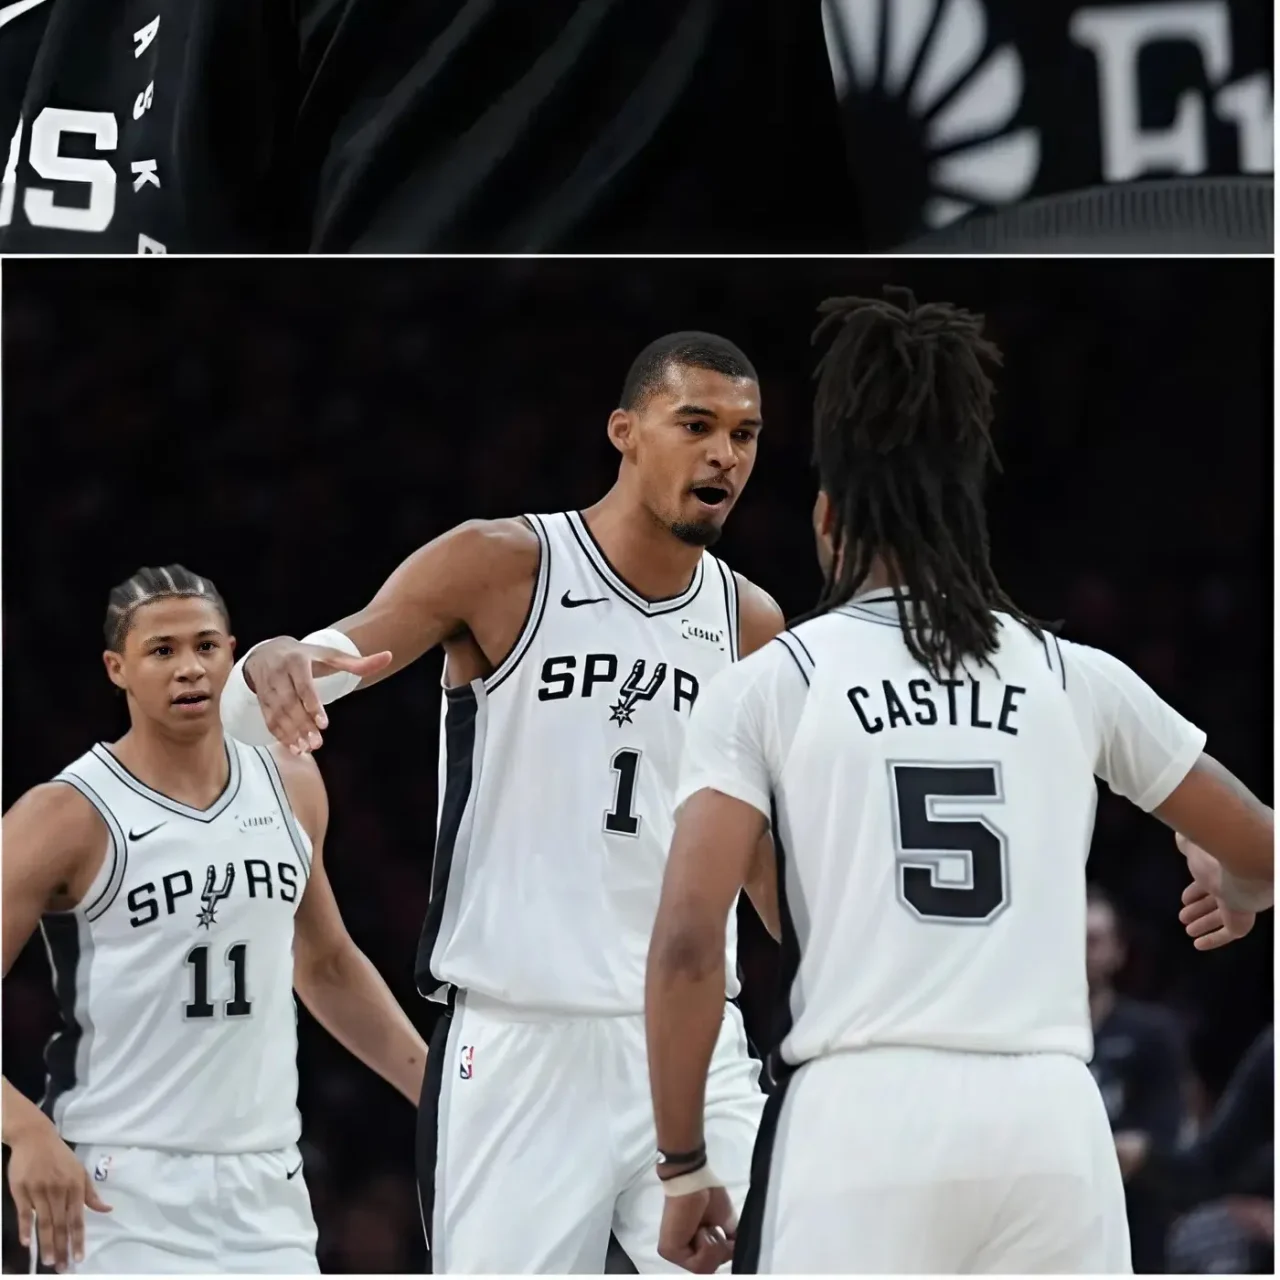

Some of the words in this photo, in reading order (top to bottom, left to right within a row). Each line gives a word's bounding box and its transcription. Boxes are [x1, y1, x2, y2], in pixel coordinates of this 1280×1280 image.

[537, 653, 700, 729] SPUR
[846, 678, 1027, 736] CASTLE
[602, 746, 643, 838] 1
[885, 758, 1012, 927] 5
[127, 858, 298, 931] SPURS
[181, 939, 255, 1023] 11
